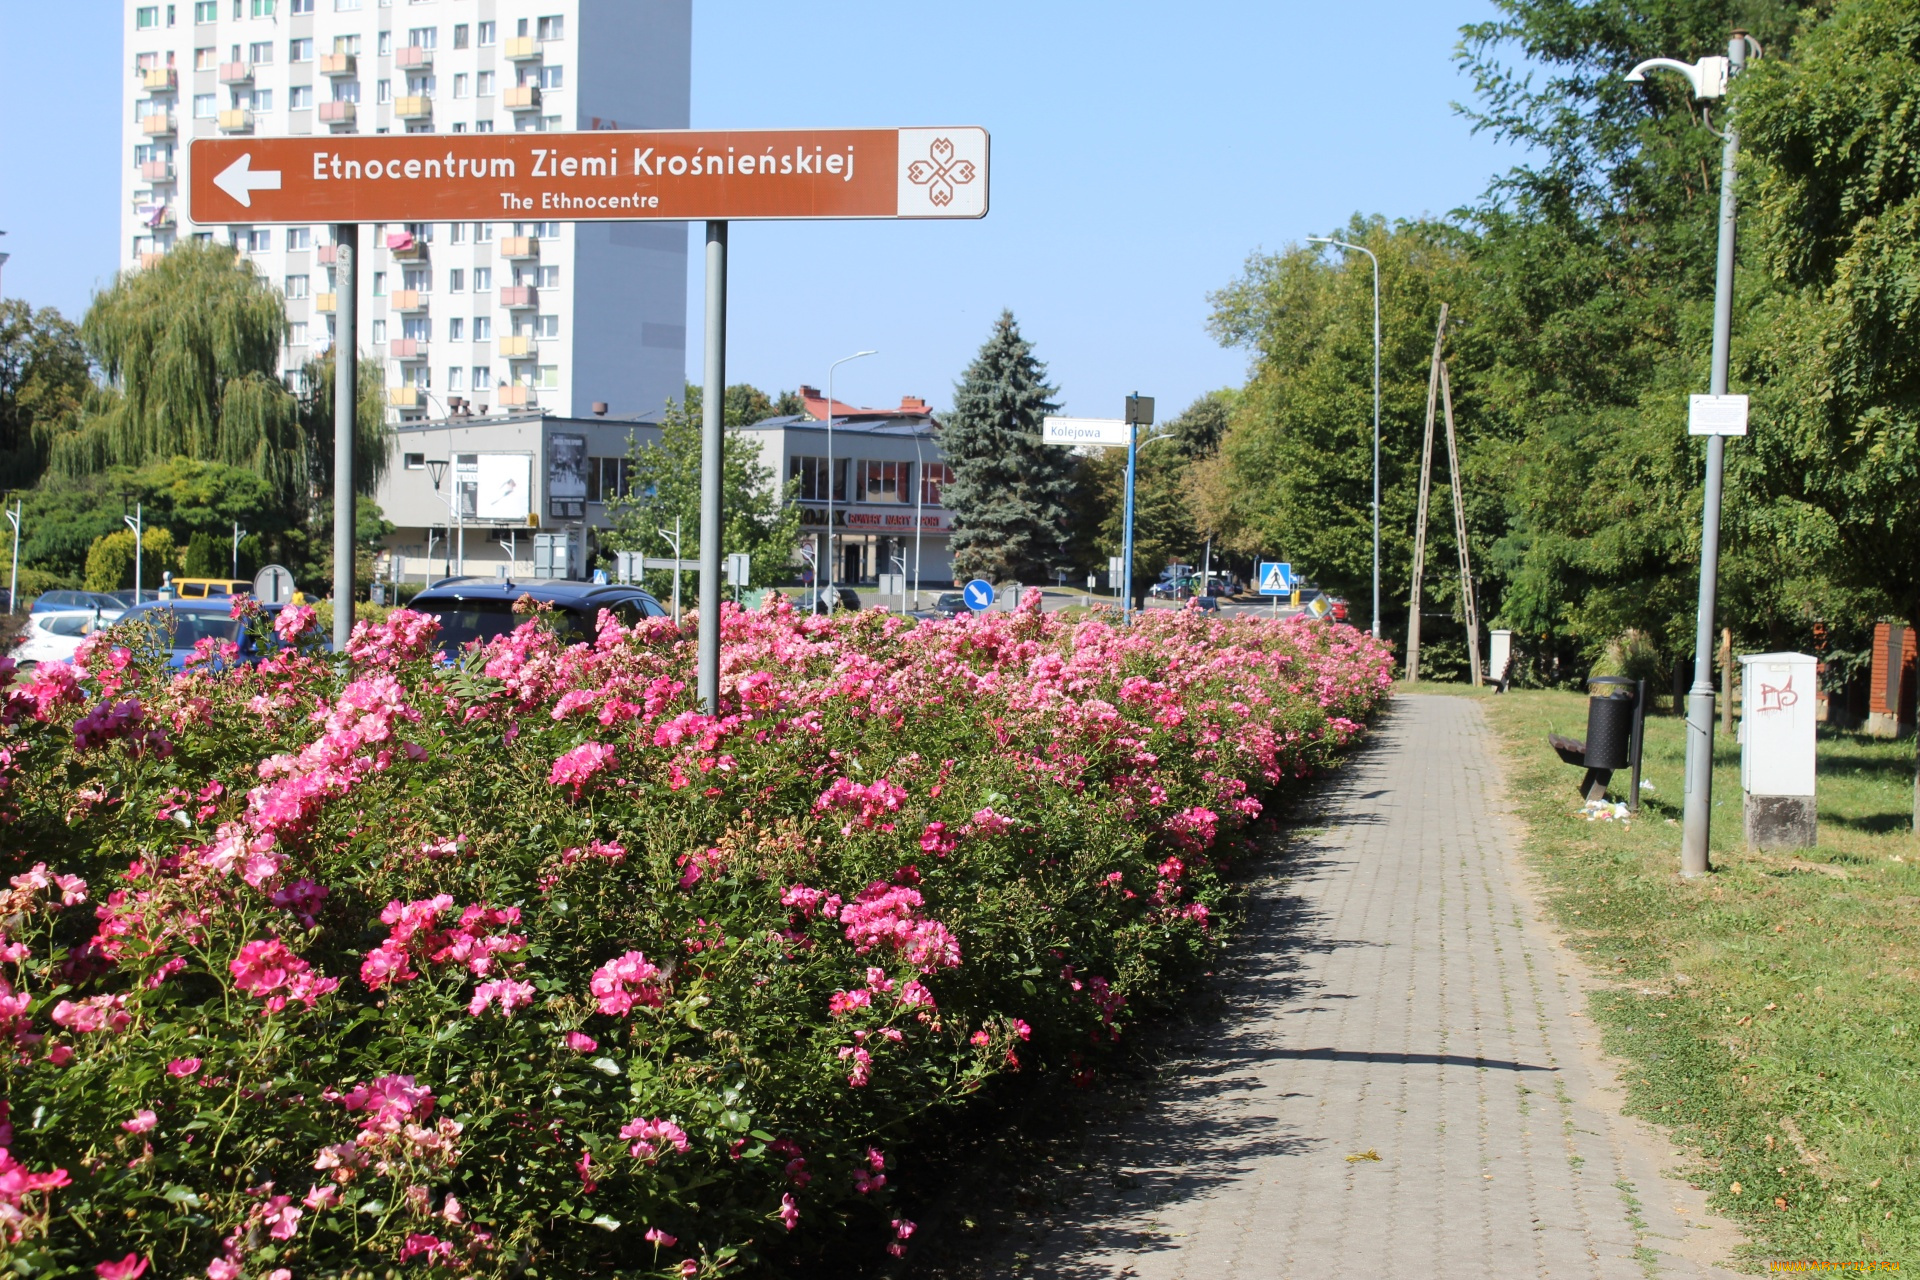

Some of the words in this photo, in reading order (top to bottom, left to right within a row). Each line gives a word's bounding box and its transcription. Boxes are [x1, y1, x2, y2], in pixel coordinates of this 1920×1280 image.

[313, 150, 515, 180] Etnocentrum
[531, 148, 617, 177] Ziemi
[633, 145, 854, 182] Krośnieńskiej
[500, 192, 533, 209] The
[541, 191, 659, 209] Ethnocentre
[1051, 426, 1101, 439] Kolejowa
[848, 513, 883, 524] ROWERY
[885, 514, 911, 526] NARTY
